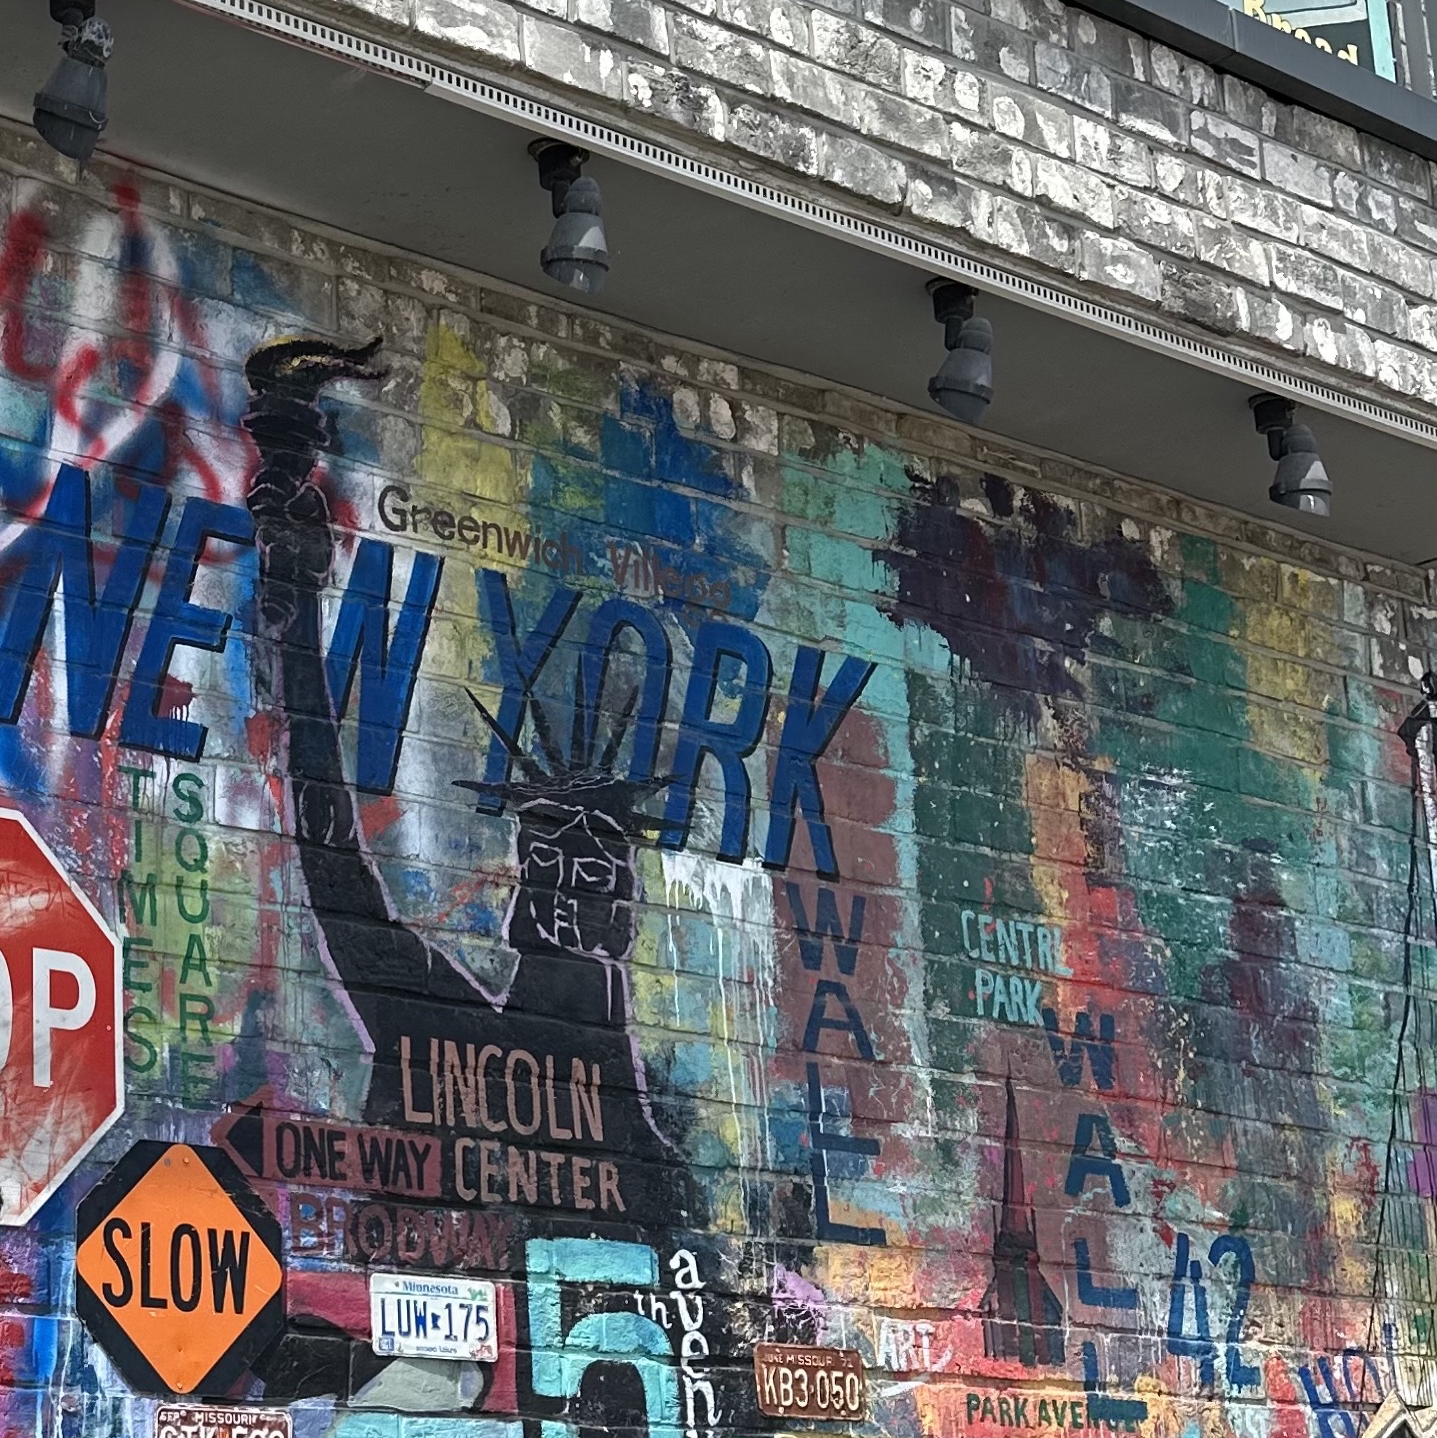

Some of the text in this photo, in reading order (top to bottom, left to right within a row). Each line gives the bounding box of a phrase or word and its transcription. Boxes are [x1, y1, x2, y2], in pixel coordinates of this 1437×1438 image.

[377, 484, 583, 577] Greenwich
[476, 567, 878, 882] YORK
[117, 765, 219, 1111] TIMES SQUARE
[975, 969, 1046, 1026] PARK
[399, 1034, 605, 1142] LINCOLN
[785, 880, 888, 1246] WALL
[275, 1121, 432, 1191] ONE WAY
[453, 1137, 627, 1213] CENTER
[101, 1217, 252, 1315] SLOW
[402, 1281, 459, 1296] Minnesota
[1166, 1232, 1262, 1393] 42
[195, 1411, 252, 1425] MISSOURI
[966, 1392, 1034, 1429] PARK
